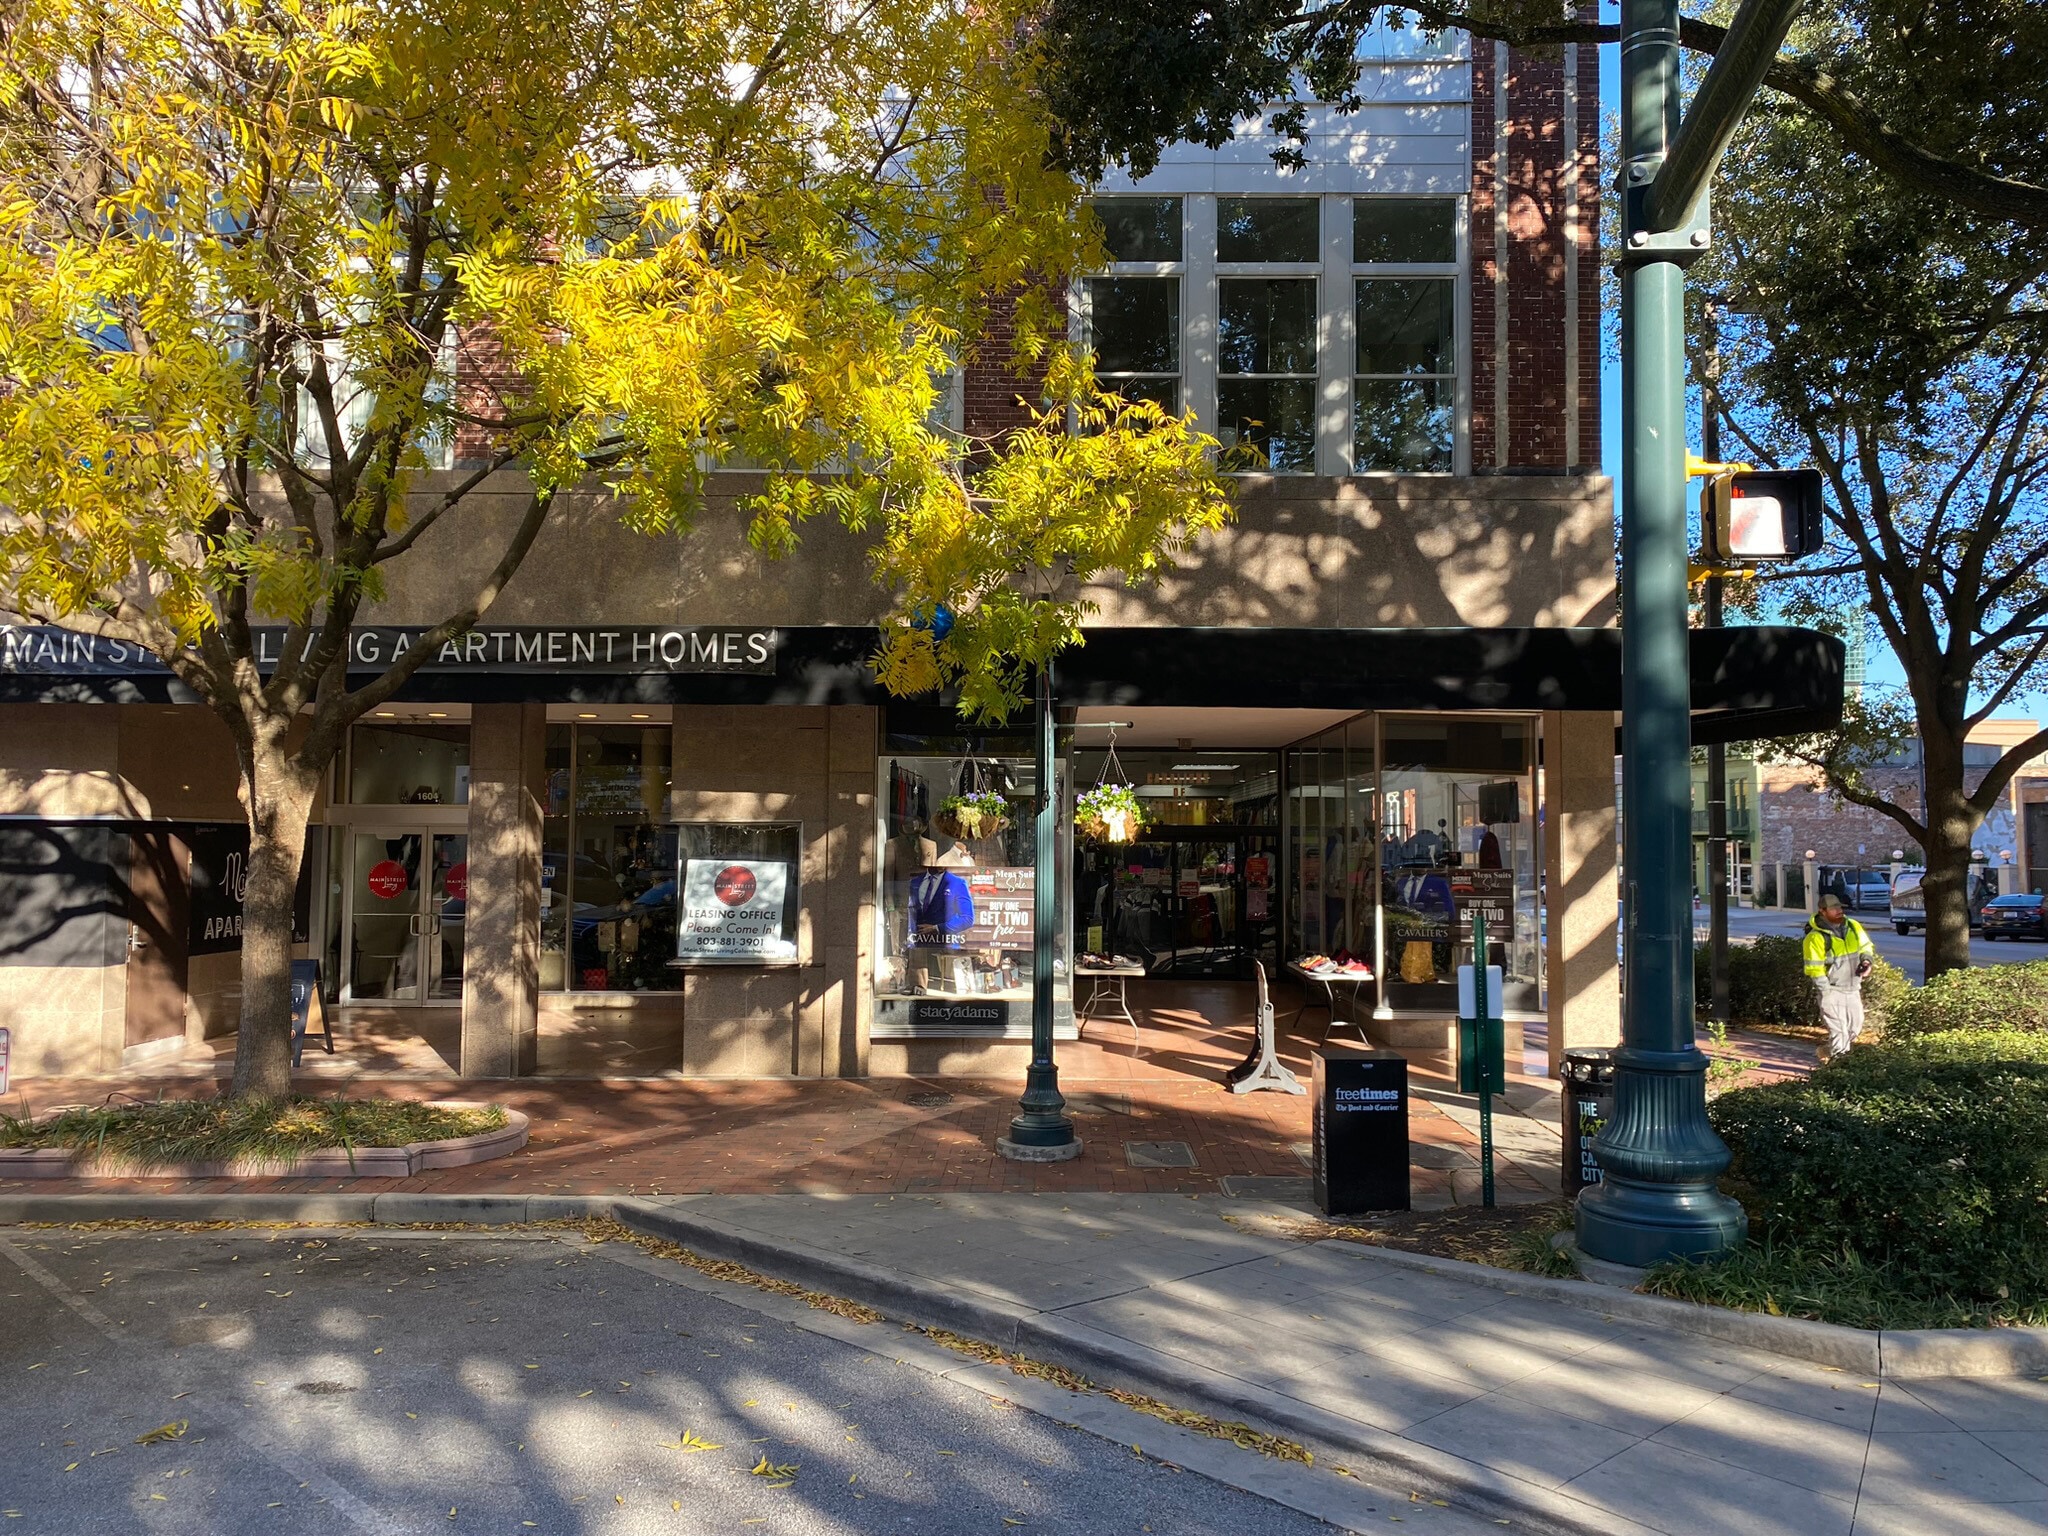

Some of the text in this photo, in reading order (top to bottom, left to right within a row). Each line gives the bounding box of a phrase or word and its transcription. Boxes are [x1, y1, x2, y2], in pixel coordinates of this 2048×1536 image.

[3, 633, 95, 663] MAIN
[391, 632, 620, 663] AARTMENT
[632, 632, 769, 664] HOMES
[417, 792, 439, 801] 1604
[543, 867, 554, 876] EN
[995, 870, 1016, 878] Mens
[989, 902, 1019, 911] BUY ONE
[1468, 900, 1496, 908] BUY ONE
[689, 909, 776, 920] LEASING OFFICE
[980, 912, 1028, 925] GET TWO
[1460, 909, 1504, 921] GET TWO
[687, 921, 776, 934] Please Come In!
[992, 923, 1015, 940] free
[1397, 928, 1449, 937] CAVALIER'S
[696, 937, 764, 946] 803-881-3901
[908, 933, 966, 944] CAVALIER'S
[920, 1006, 999, 1020] stacyadams
[1335, 1087, 1399, 1100] freetimes
[1348, 1104, 1362, 1112] Post
[1578, 1101, 1598, 1116] THE
[1582, 1168, 1605, 1182] CITY
